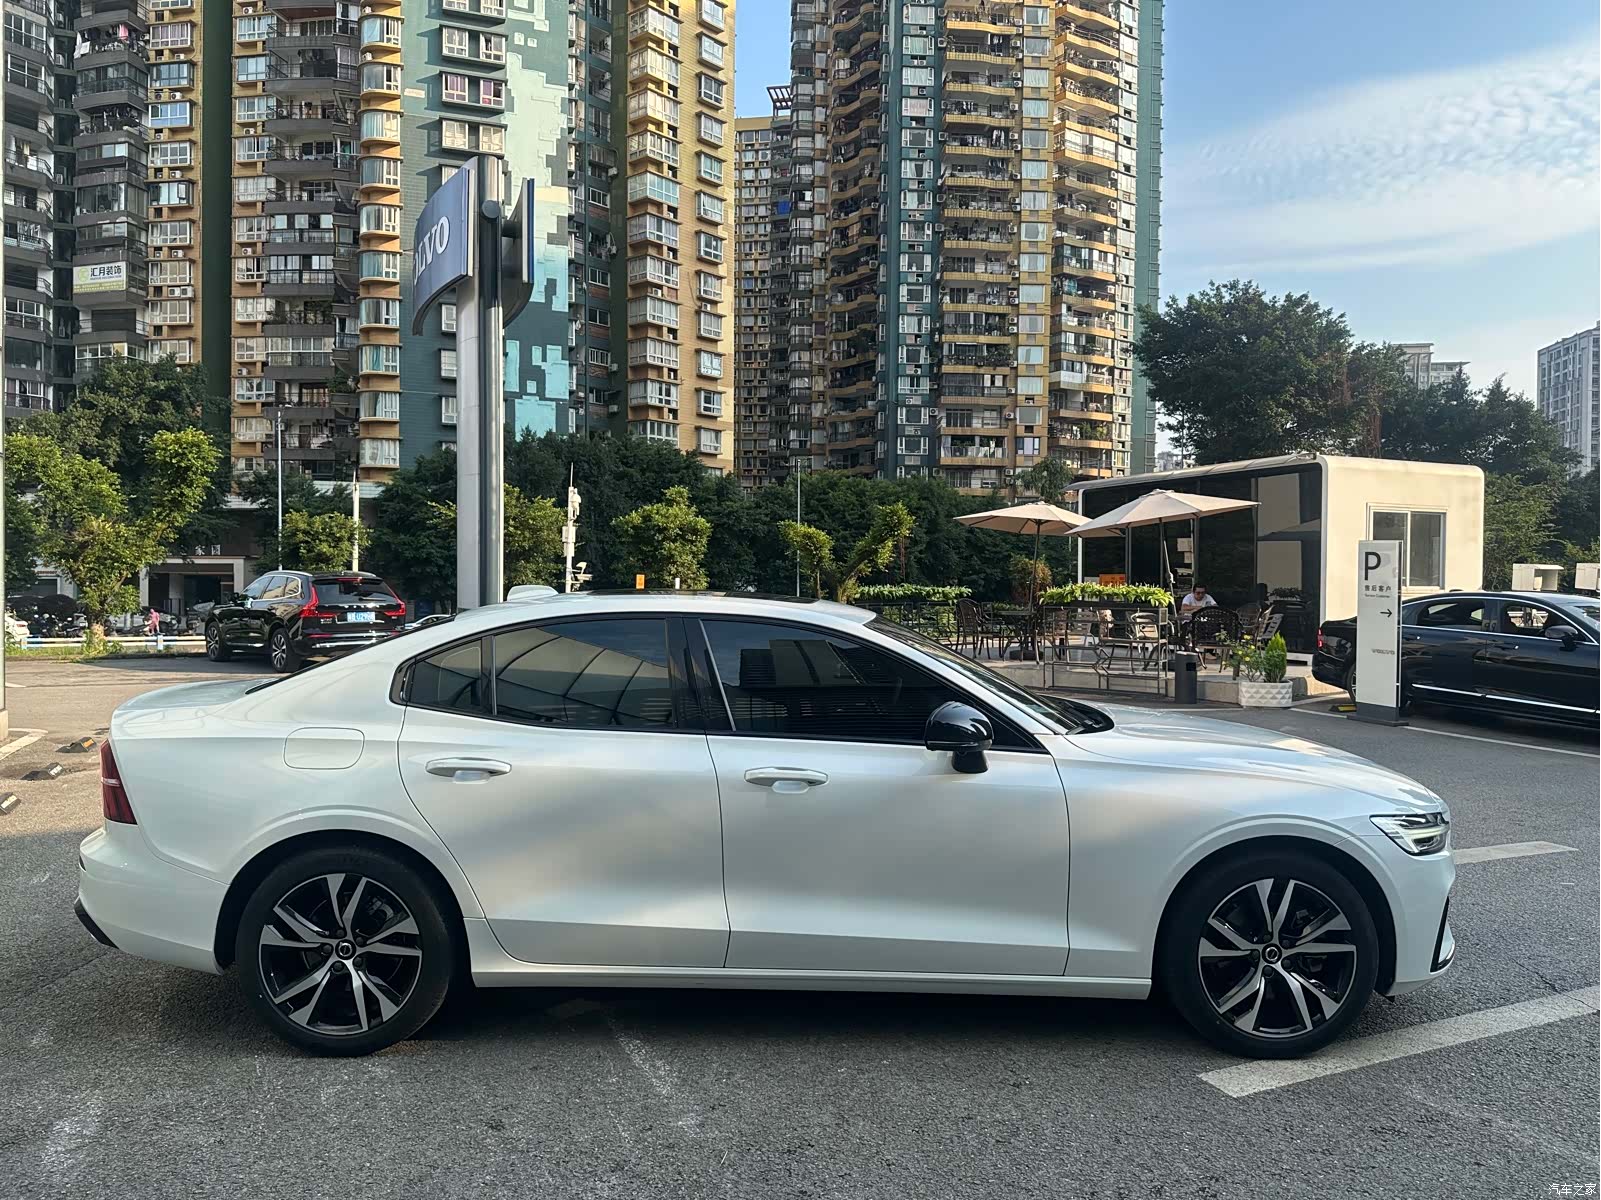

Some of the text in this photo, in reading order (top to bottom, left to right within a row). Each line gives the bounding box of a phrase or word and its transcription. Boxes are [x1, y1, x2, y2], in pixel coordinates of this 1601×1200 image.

[90, 265, 122, 277] 汇月装饰
[1364, 551, 1382, 581] P
[1364, 584, 1392, 593] 售后客户
